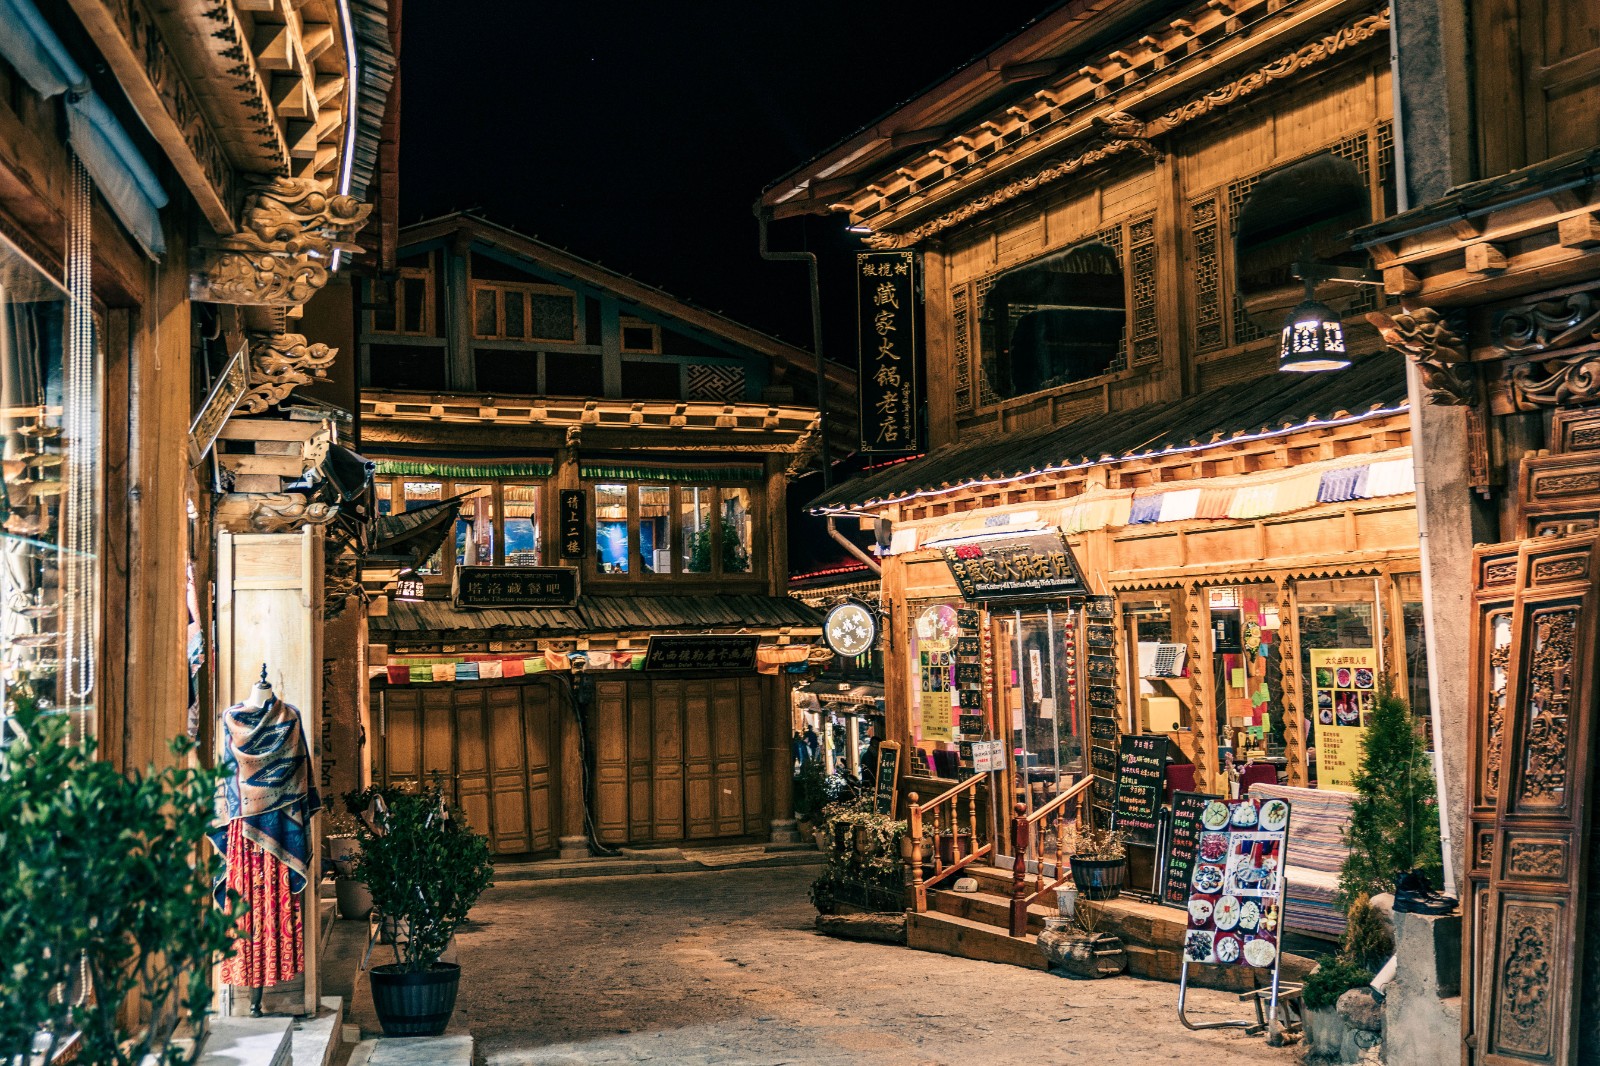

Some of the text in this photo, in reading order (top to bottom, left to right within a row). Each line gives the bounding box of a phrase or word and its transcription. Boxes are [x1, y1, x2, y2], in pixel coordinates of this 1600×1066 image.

[873, 282, 902, 444] 藏家火锅老店
[566, 495, 581, 554] 请上二楼
